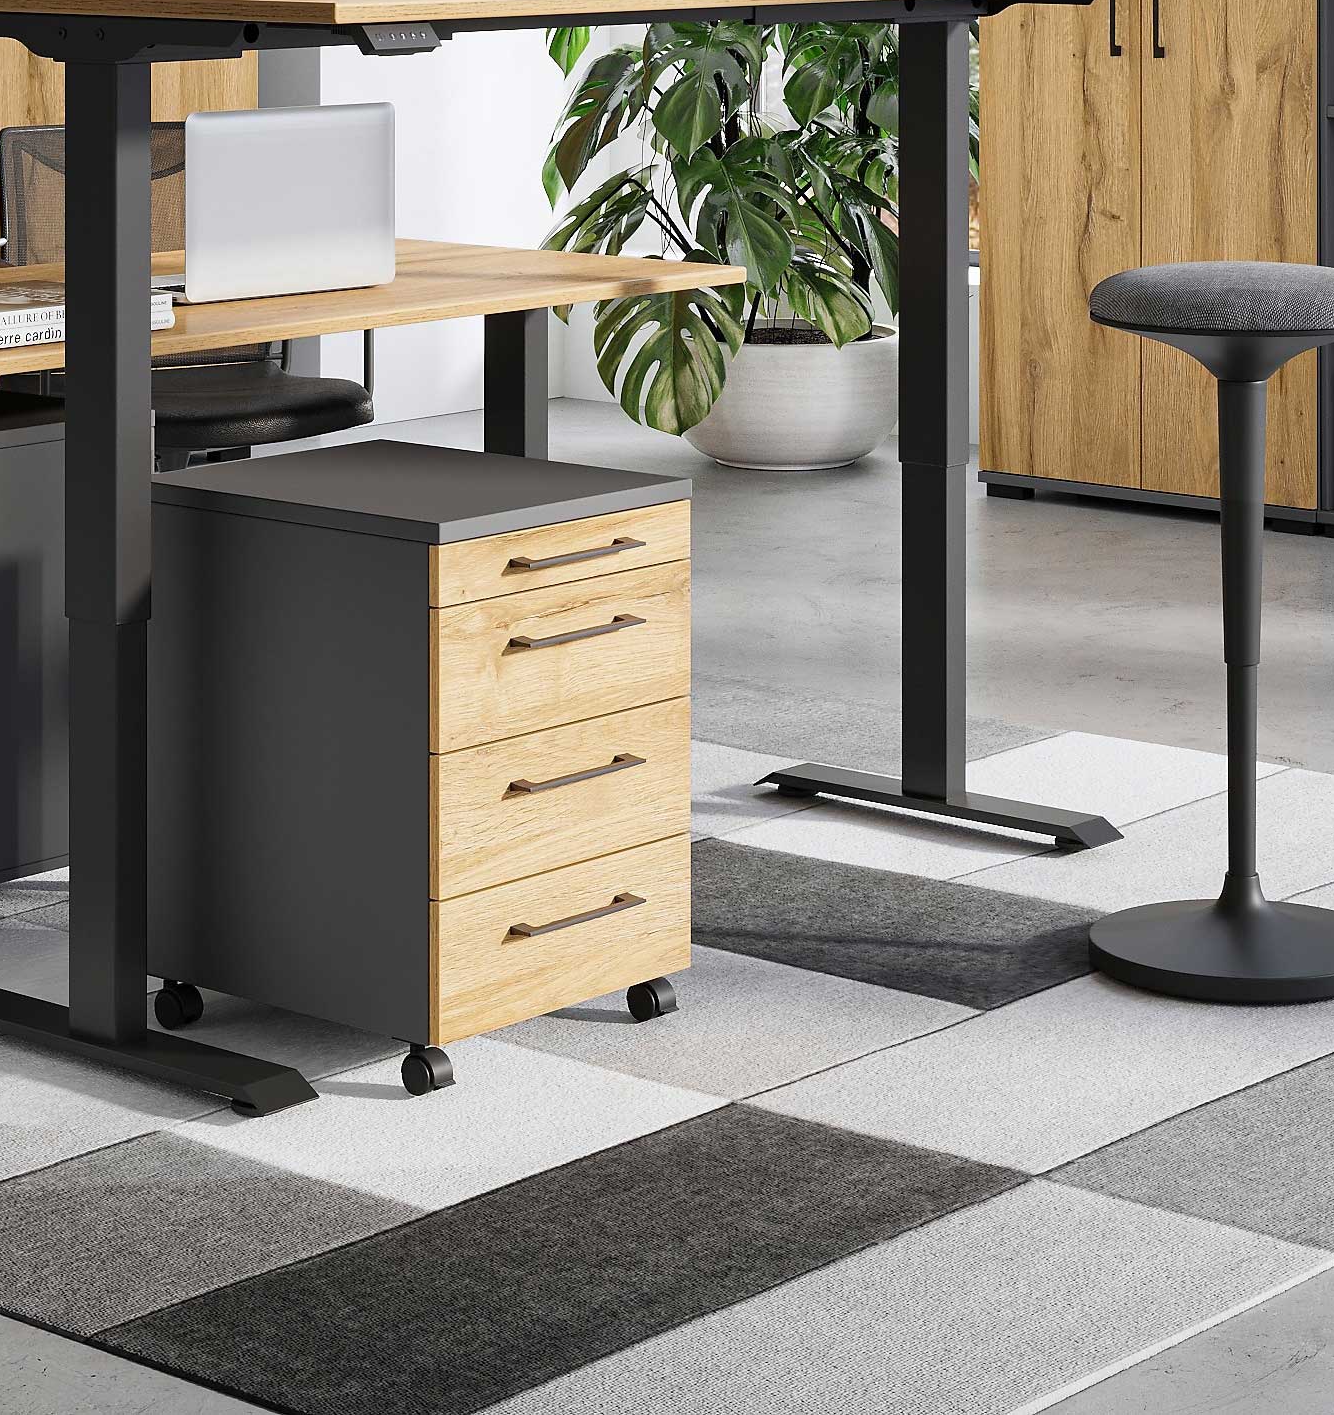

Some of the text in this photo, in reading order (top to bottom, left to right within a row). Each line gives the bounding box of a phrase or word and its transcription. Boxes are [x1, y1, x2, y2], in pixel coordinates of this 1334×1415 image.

[1, 313, 38, 326] ALLURE
[40, 311, 54, 321] OF
[26, 327, 62, 341] cardin
